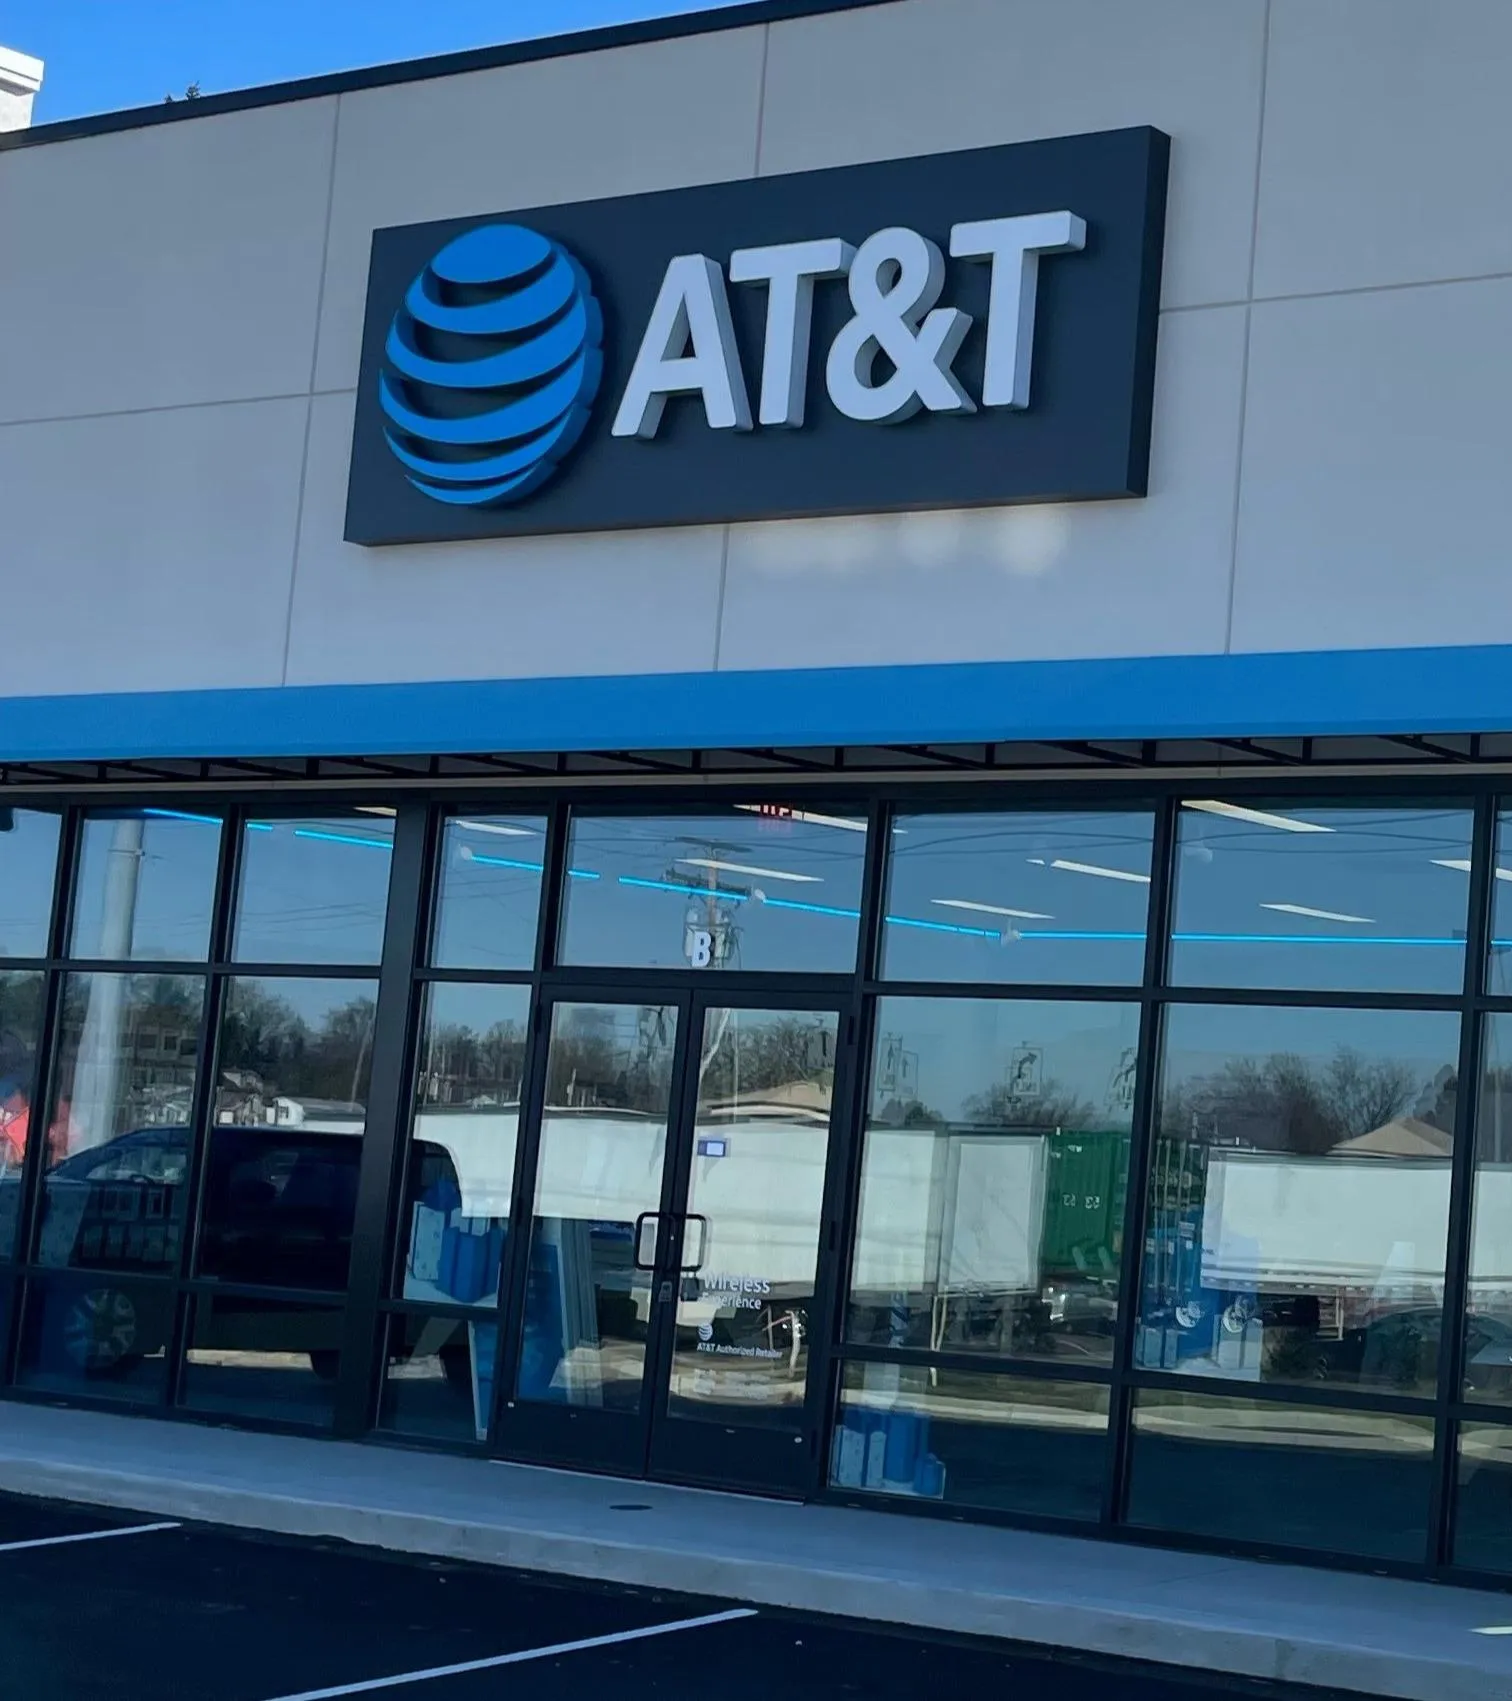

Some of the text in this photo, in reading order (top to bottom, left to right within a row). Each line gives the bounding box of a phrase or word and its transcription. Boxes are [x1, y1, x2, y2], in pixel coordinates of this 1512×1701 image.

[611, 210, 1087, 439] AT&T
[691, 931, 712, 968] B
[704, 1272, 770, 1293] Wireless
[697, 1342, 715, 1352] AT&T
